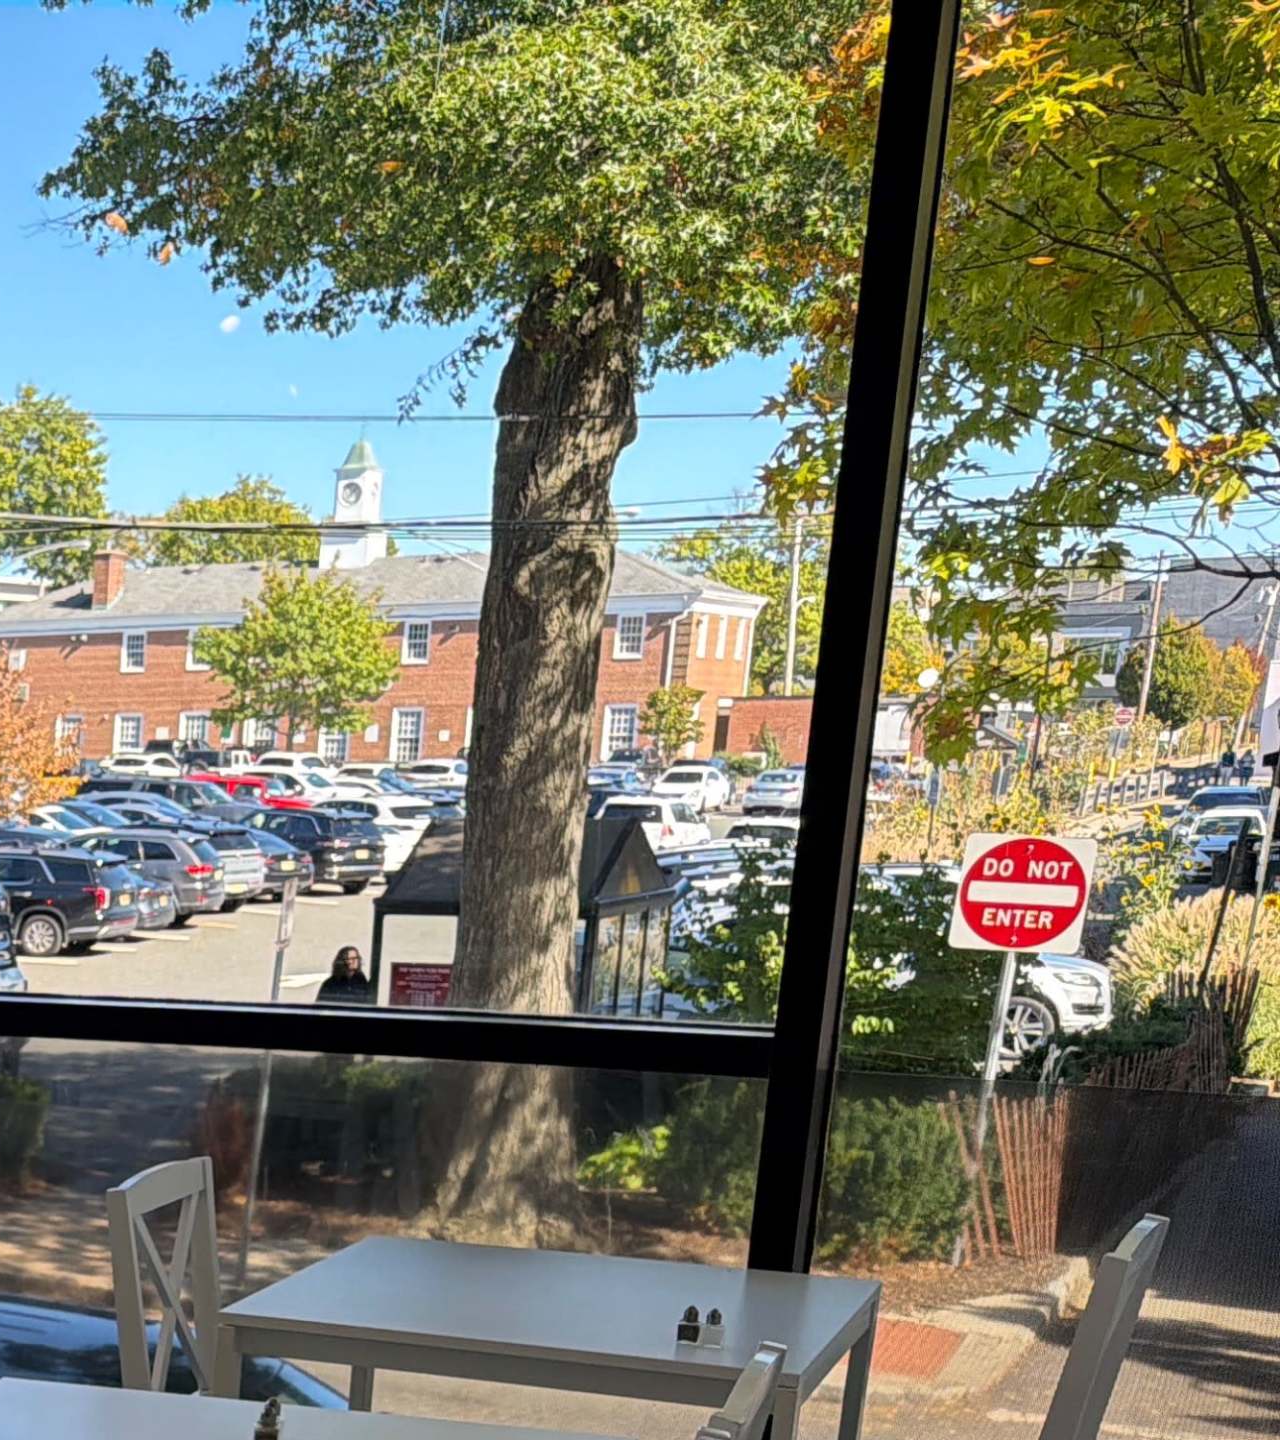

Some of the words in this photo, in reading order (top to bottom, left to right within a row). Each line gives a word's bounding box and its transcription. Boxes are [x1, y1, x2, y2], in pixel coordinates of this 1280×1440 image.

[982, 857, 1014, 877] DO
[1028, 861, 1073, 880] NOT
[982, 908, 1054, 929] ENTER
